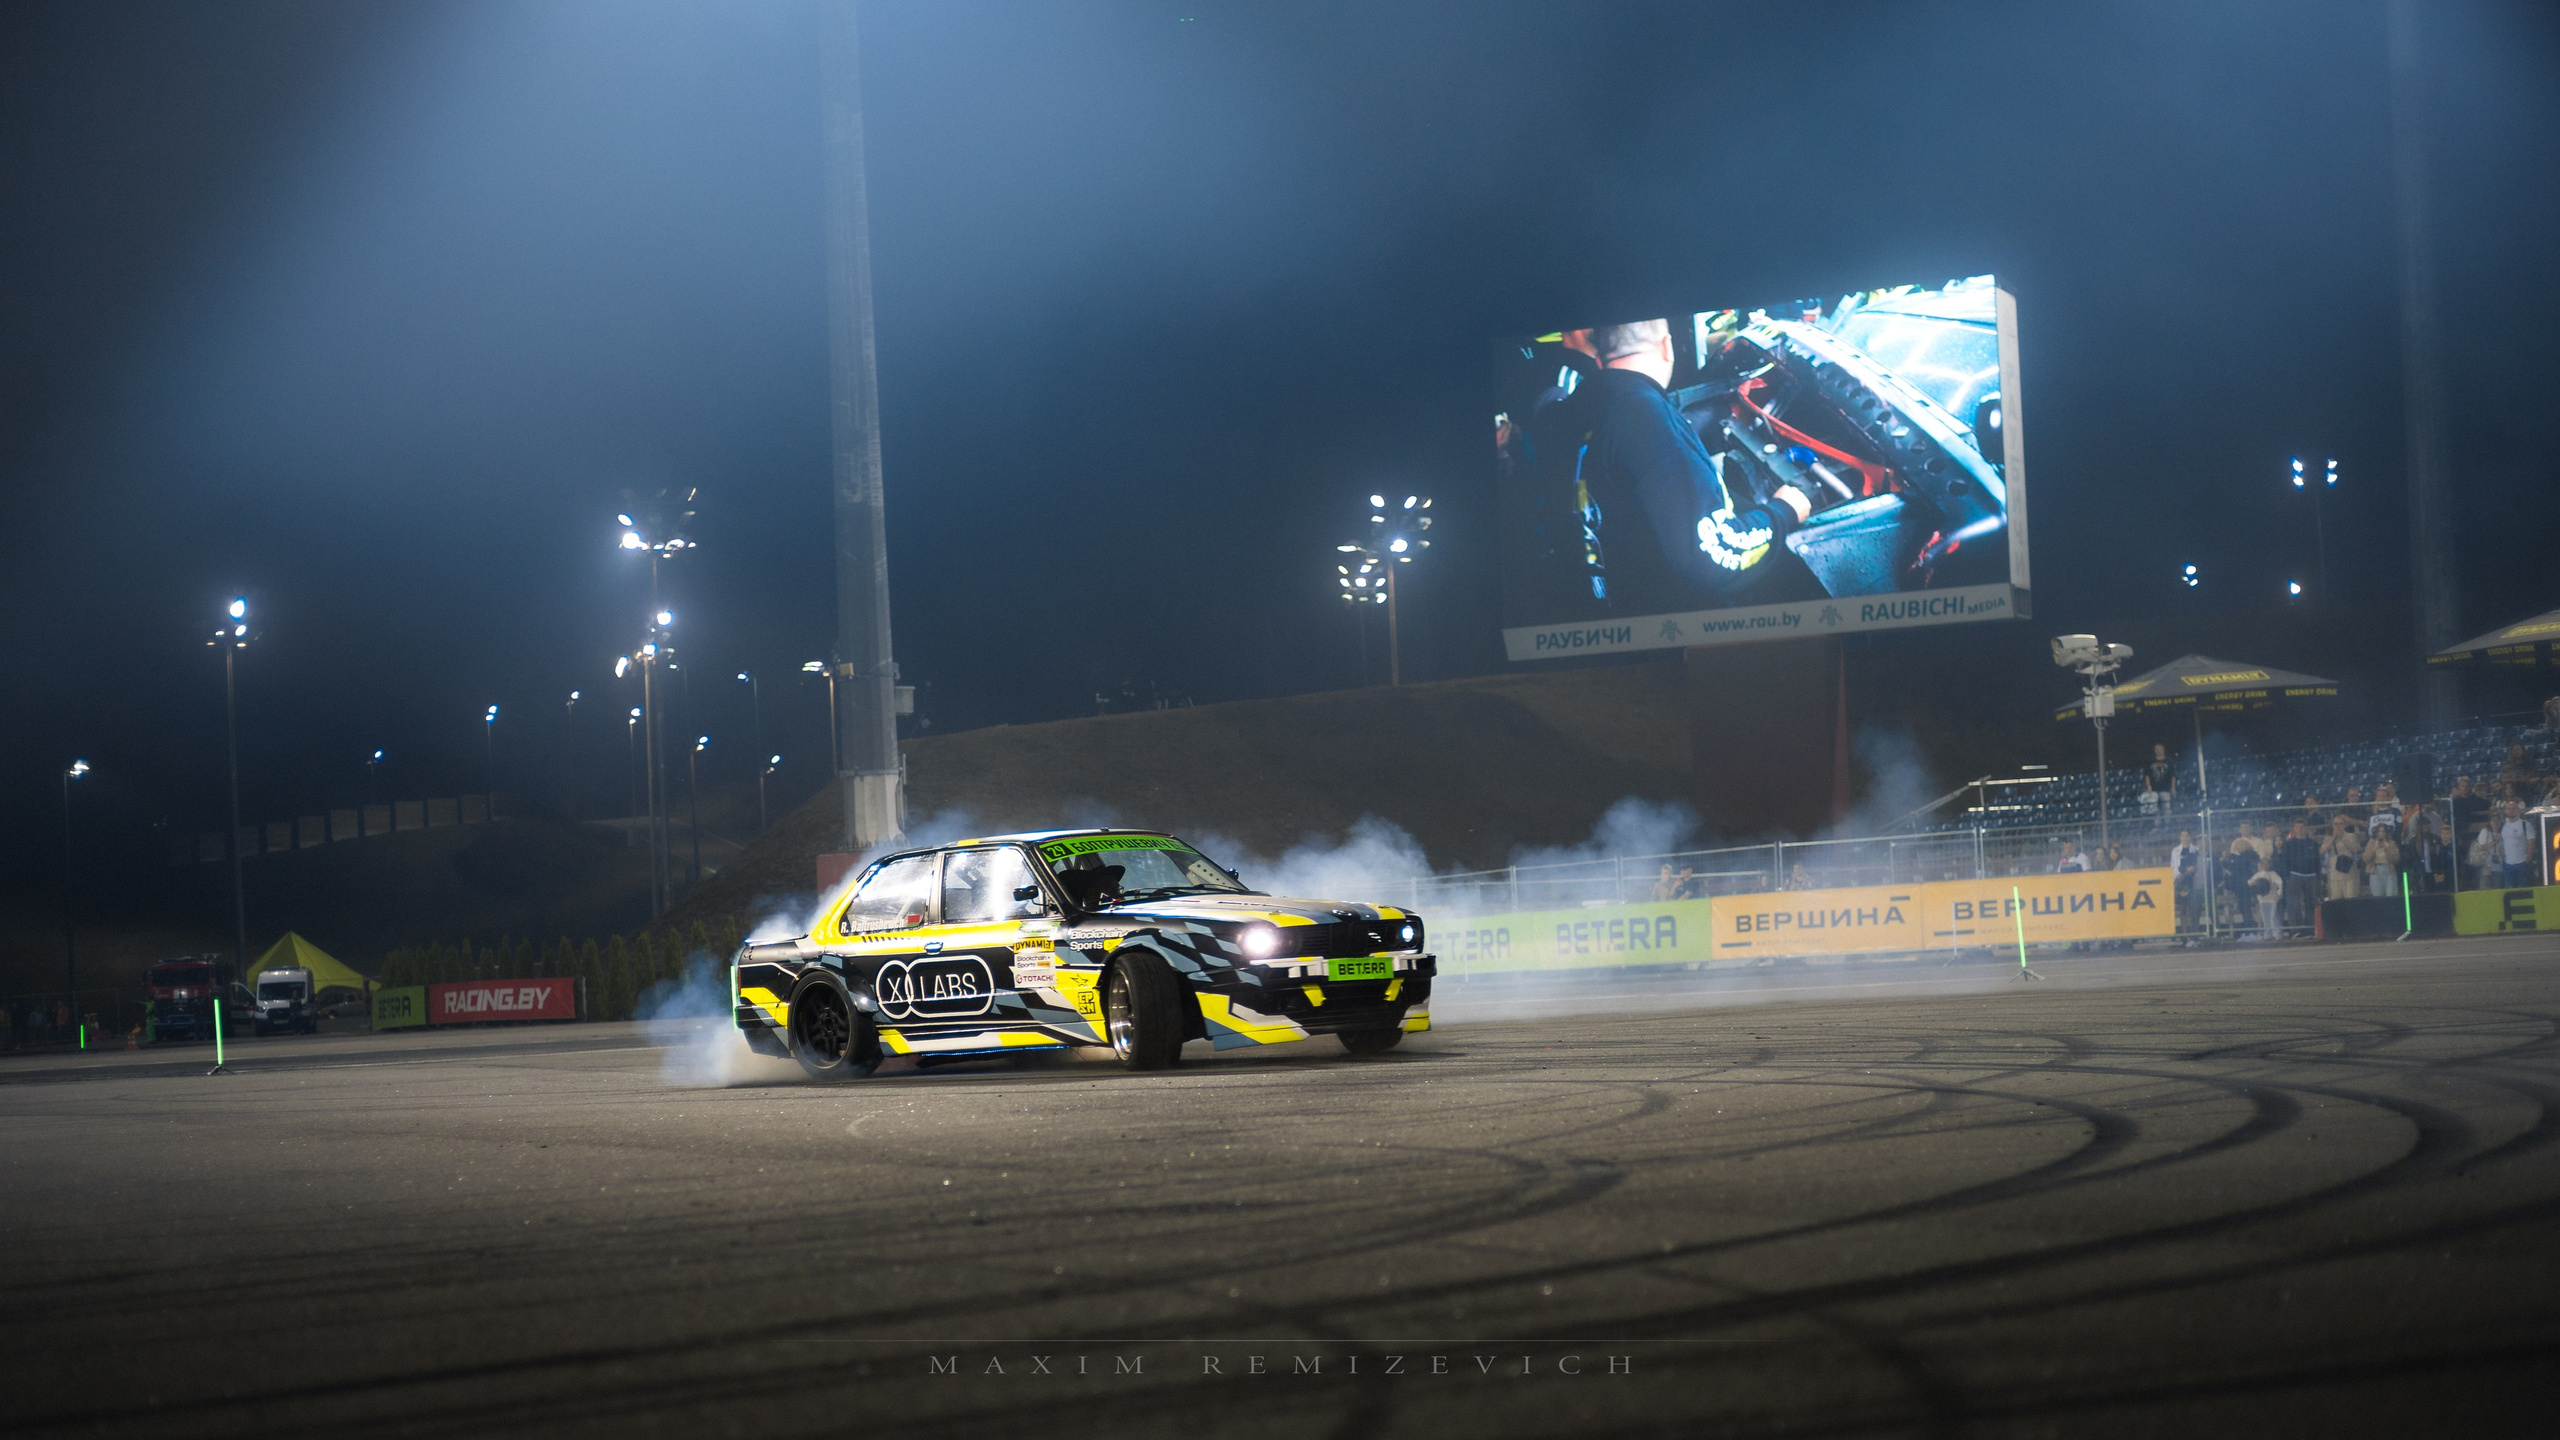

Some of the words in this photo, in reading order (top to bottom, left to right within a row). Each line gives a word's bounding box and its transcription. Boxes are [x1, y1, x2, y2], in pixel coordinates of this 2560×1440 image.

[1861, 596, 1964, 621] RAUBICHI
[1968, 597, 2005, 615] MEDIA
[1703, 611, 1800, 633] www.rau.by
[1536, 626, 1631, 650] РАУБИЧИ
[2215, 691, 2243, 700] ENERGY
[2244, 690, 2268, 699] DRINK
[2285, 689, 2314, 697] ENERGY
[2316, 688, 2338, 696] DRINK
[1047, 845, 1065, 857] 29
[1070, 838, 1170, 852] БОЛТРУШЕВИЧ
[1954, 890, 2157, 920] ВЕРШИНА
[840, 921, 849, 934] R.
[1736, 906, 1906, 933] ВЕРШИНА
[1069, 928, 1123, 940] Blockchain
[1069, 940, 1103, 951] Sports
[887, 977, 904, 1003] X
[919, 972, 977, 1001] LABS
[1023, 974, 1053, 982] TOTACHI
[444, 987, 551, 1014] RACING.BY
